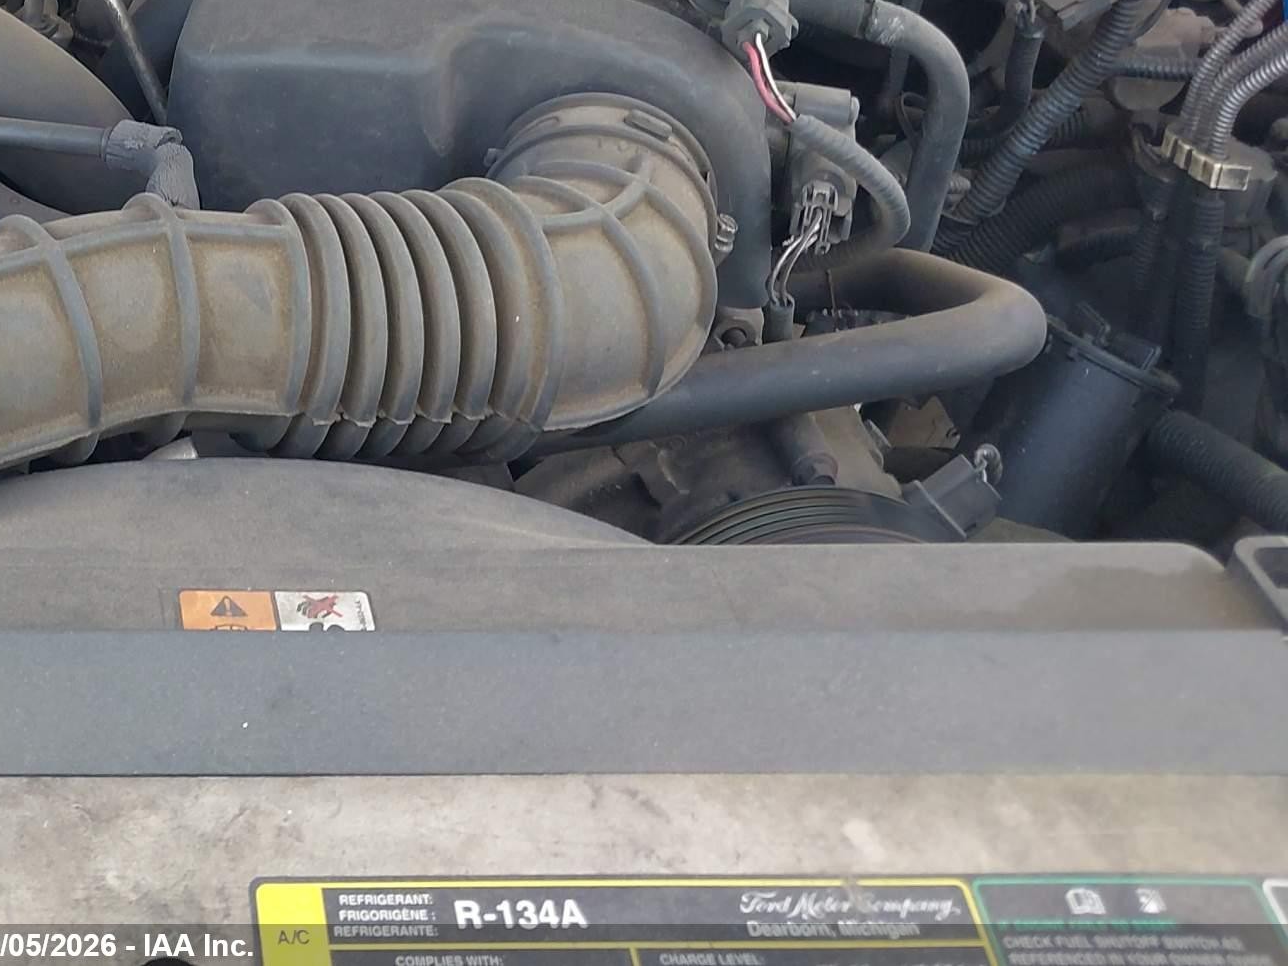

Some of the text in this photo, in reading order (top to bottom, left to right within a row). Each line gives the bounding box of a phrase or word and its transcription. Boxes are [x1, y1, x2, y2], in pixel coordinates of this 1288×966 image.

[338, 894, 434, 905] REFRIGERANT:
[453, 898, 588, 931] R-134A
[333, 924, 439, 938] REFRIGERANTE:
[838, 921, 921, 939] Michigan
[277, 929, 311, 946] A/C
[395, 955, 504, 966] COMPLIES WITH:
[659, 952, 717, 966] CHARGE
